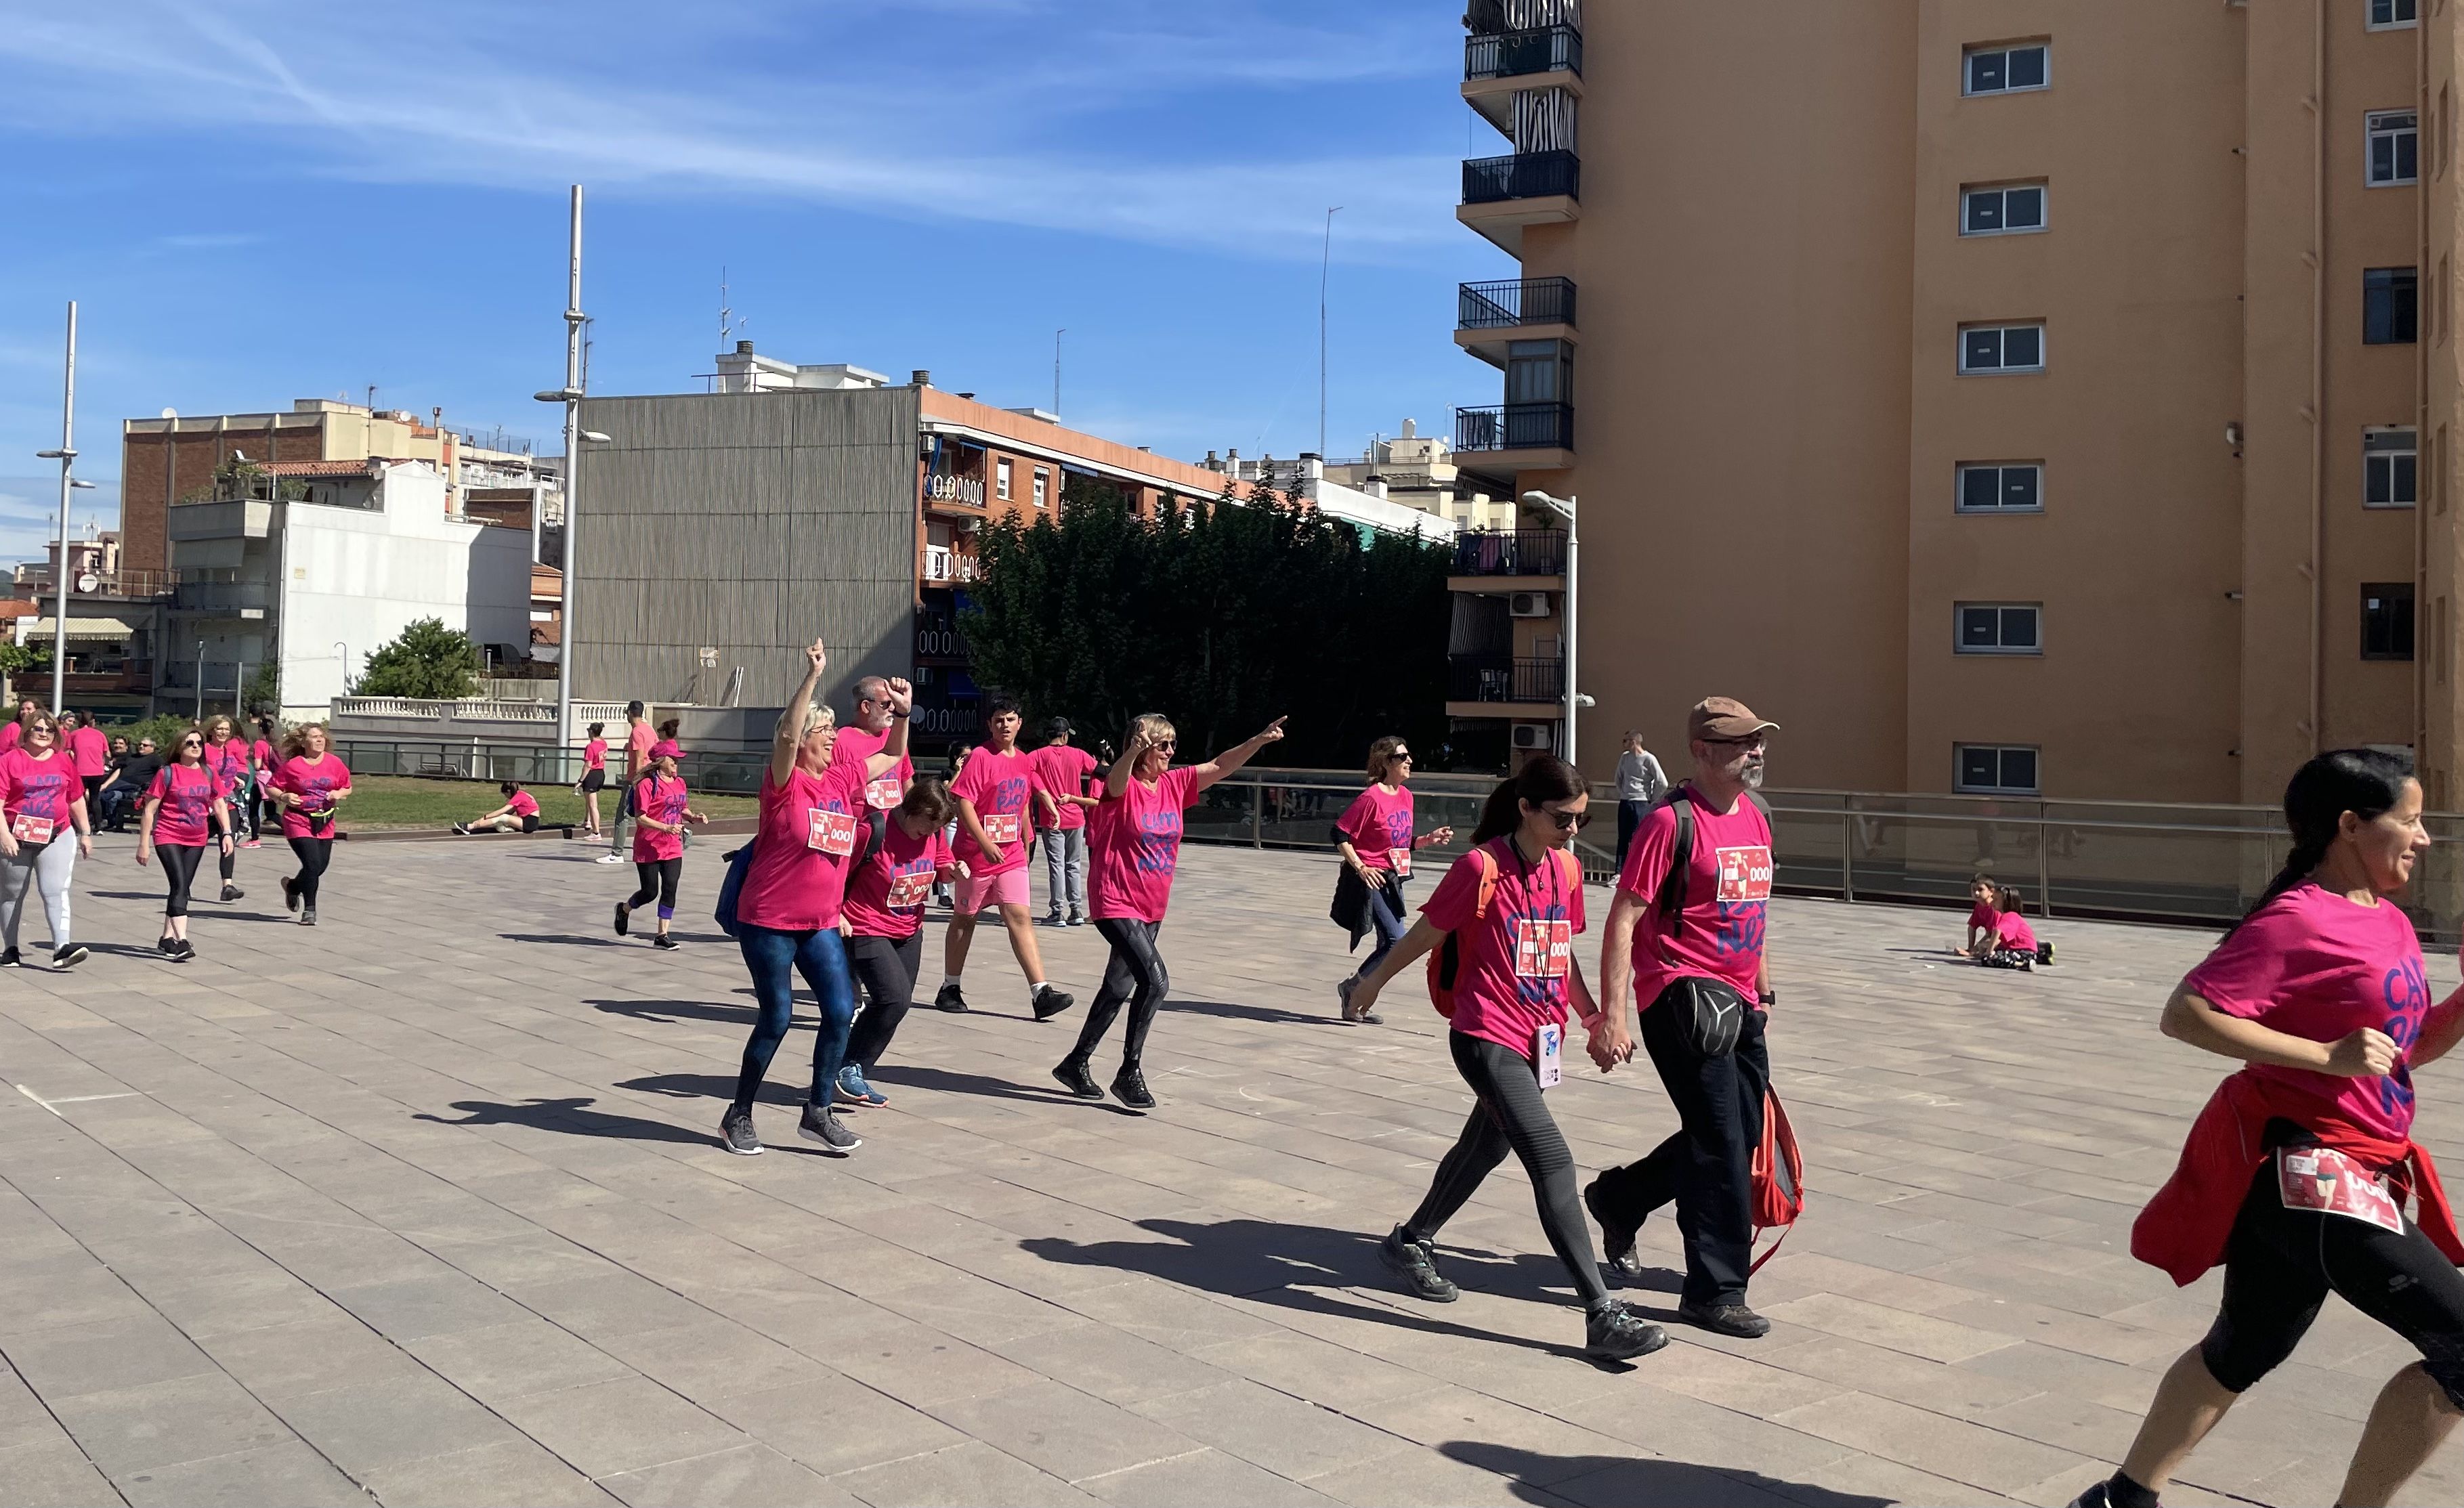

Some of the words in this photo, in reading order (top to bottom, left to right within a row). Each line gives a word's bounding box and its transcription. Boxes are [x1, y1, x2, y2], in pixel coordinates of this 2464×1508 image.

[830, 828, 851, 842] 000
[1749, 866, 1770, 882] 000
[1550, 941, 1569, 957] 000
